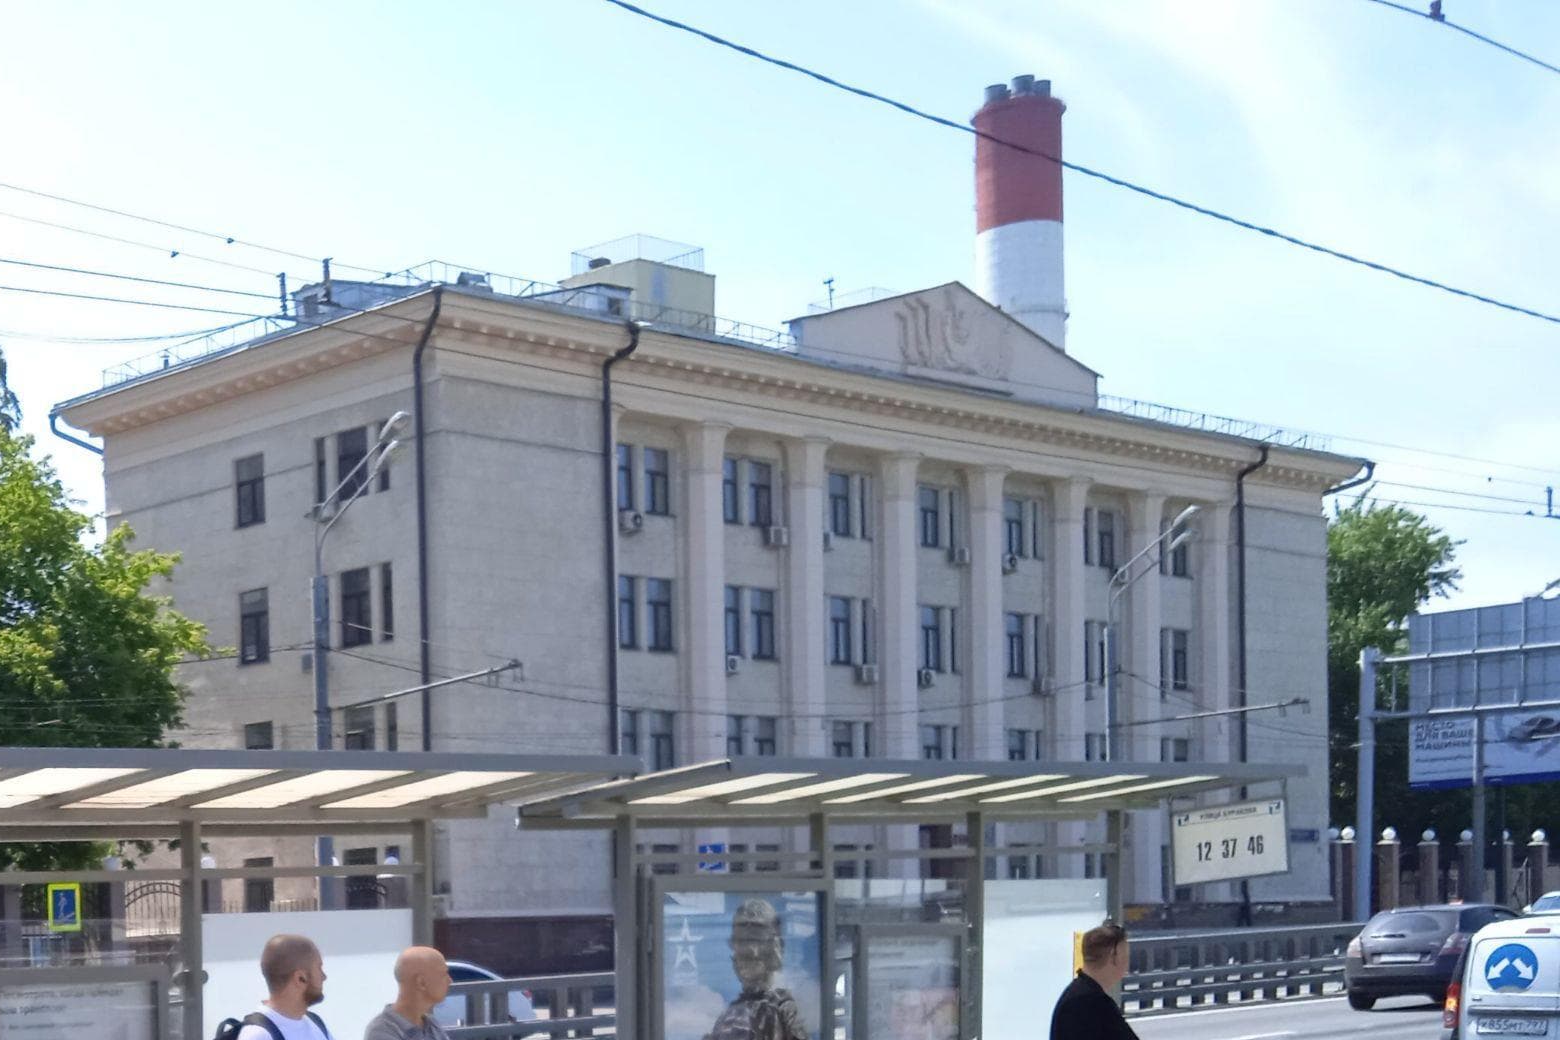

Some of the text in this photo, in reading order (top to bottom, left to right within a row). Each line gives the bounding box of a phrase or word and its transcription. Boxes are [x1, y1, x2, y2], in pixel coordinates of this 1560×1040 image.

[1196, 842, 1212, 862] 12
[1222, 838, 1238, 859] 37
[1247, 834, 1264, 855] 46
